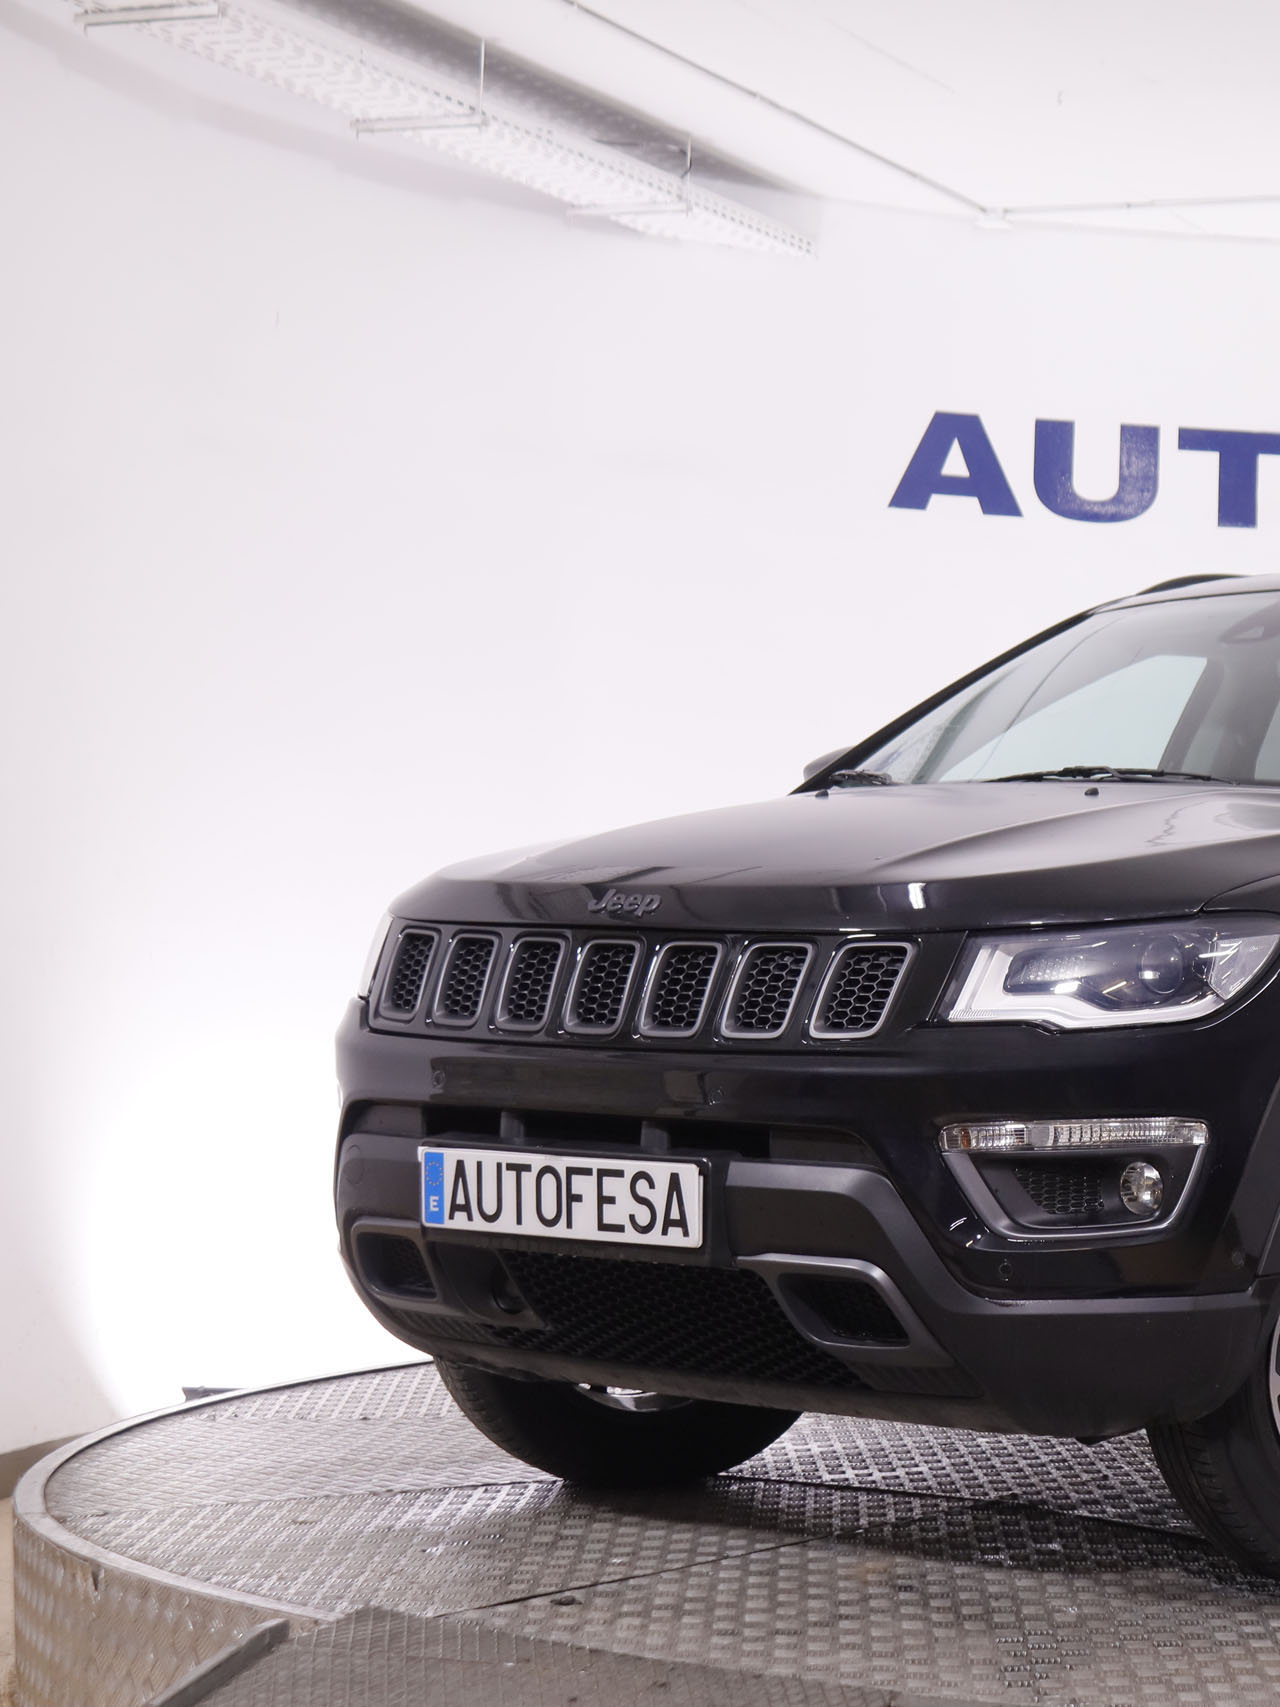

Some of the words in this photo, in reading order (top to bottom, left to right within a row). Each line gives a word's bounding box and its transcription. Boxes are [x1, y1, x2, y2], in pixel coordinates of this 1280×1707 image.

[588, 888, 661, 917] Jeep
[429, 1196, 439, 1212] E
[448, 1159, 690, 1238] AUTOFESA
